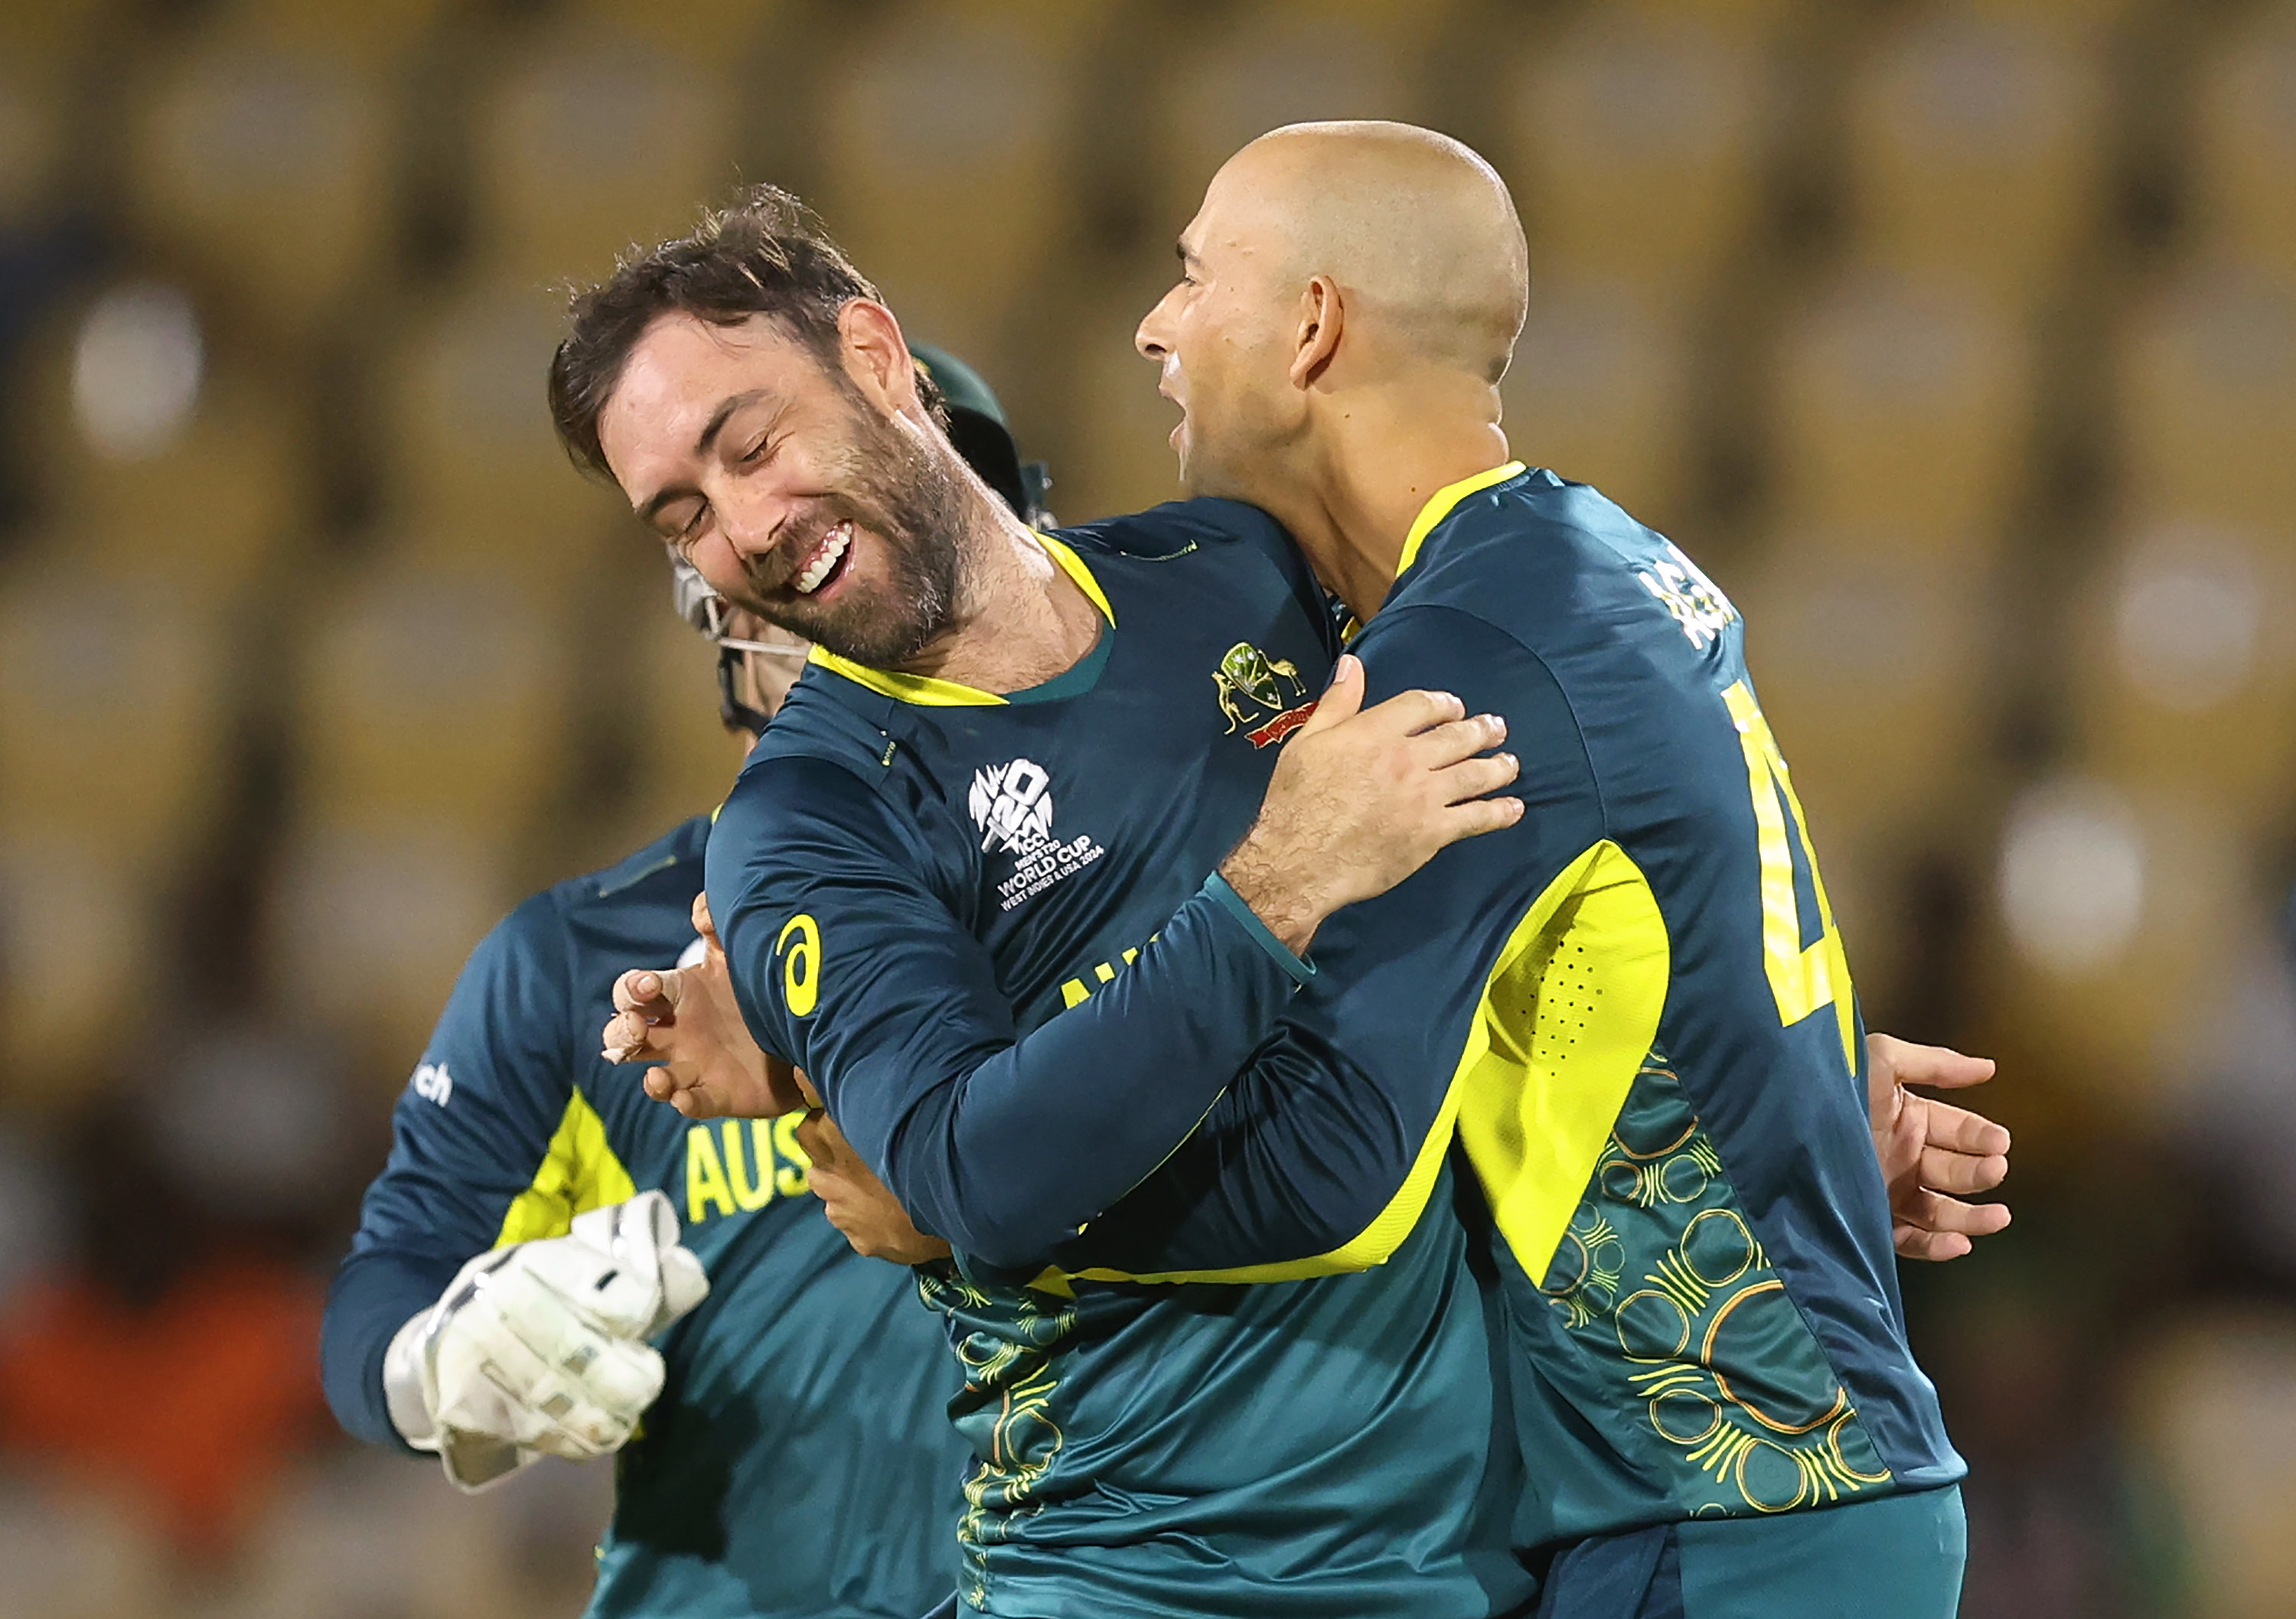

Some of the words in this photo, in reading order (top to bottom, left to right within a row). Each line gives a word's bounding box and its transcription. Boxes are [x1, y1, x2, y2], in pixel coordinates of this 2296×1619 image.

[997, 856, 1057, 897] WORLD
[1057, 835, 1091, 863] CUP
[1018, 832, 1045, 855] ICC
[1041, 839, 1062, 855] T20
[1000, 890, 1027, 912] WEST
[1026, 875, 1055, 897] INDIES
[1053, 871, 1064, 881] &
[1060, 861, 1082, 876] USA
[1079, 845, 1104, 866] 2024
[414, 1061, 453, 1108] ch
